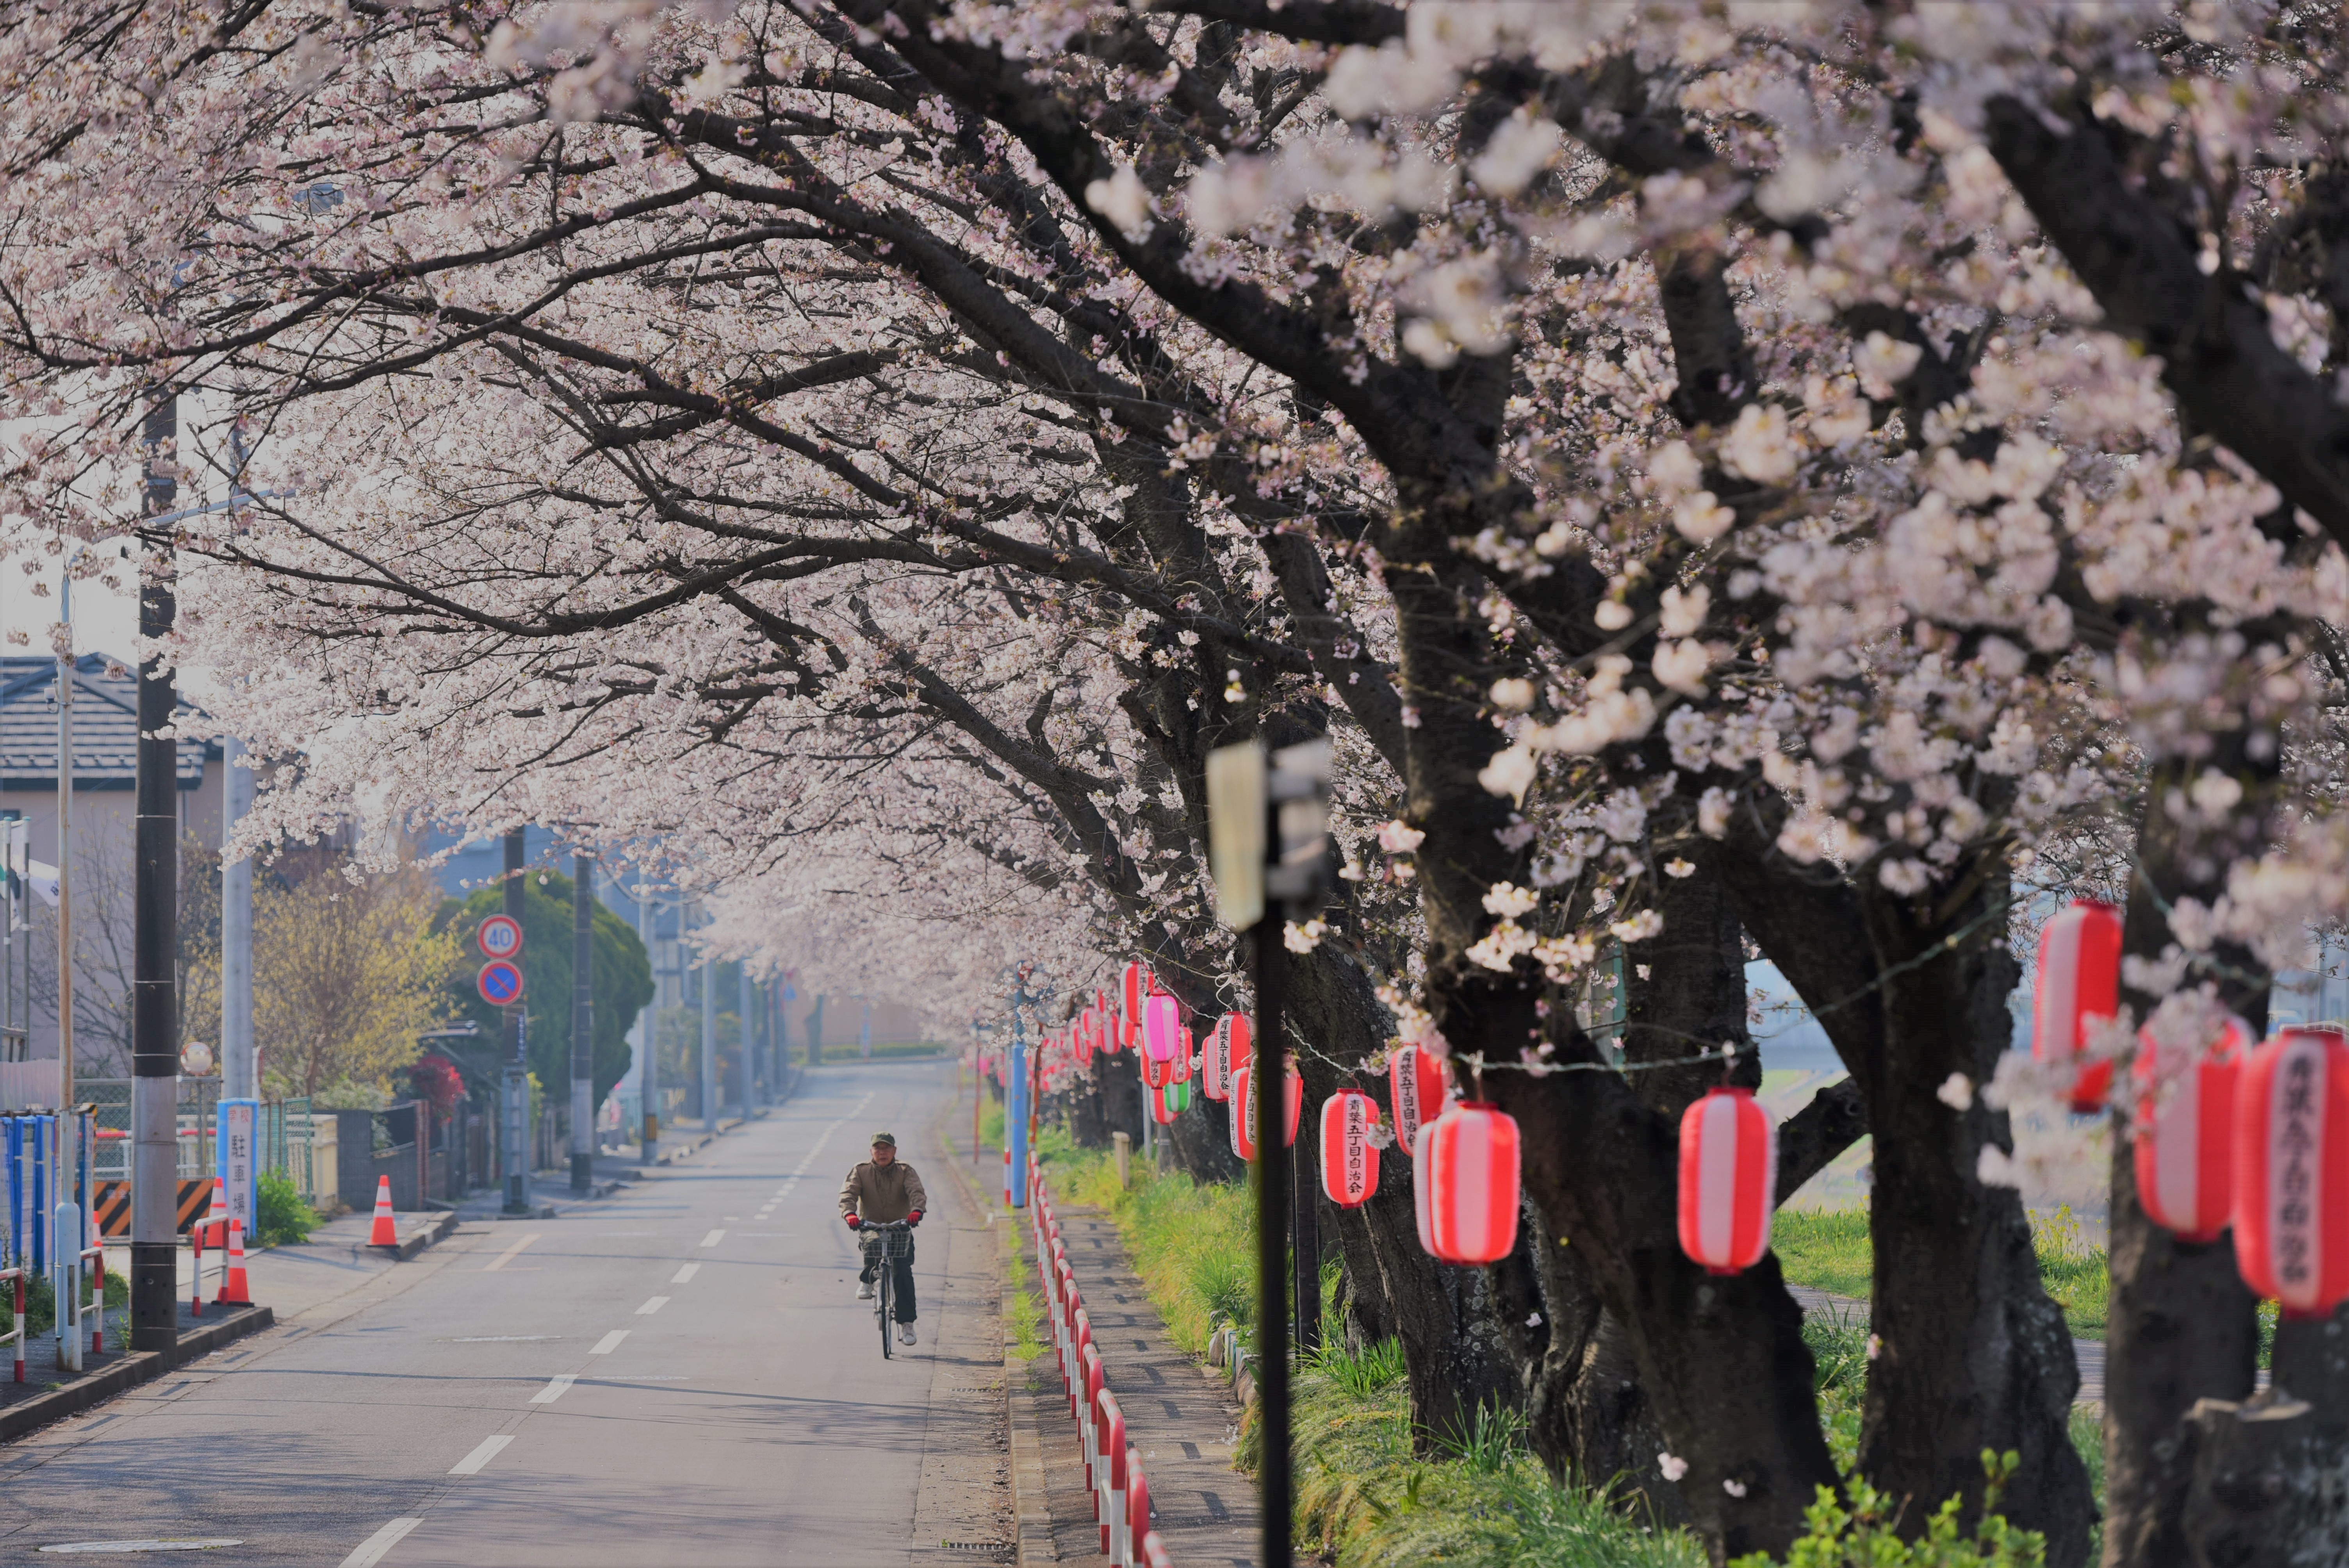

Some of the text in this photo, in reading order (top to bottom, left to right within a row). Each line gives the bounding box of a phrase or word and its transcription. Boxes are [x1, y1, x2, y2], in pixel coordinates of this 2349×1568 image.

[488, 928, 512, 947] 40
[1219, 1019, 1230, 1090] 青葉五丁目自治会
[228, 1108, 249, 1123] 学校
[1400, 1051, 1416, 1147] 青葉五丁目自治会
[231, 1134, 246, 1214] 駐車場
[1347, 1099, 1363, 1194] 青葉五丁目自治会
